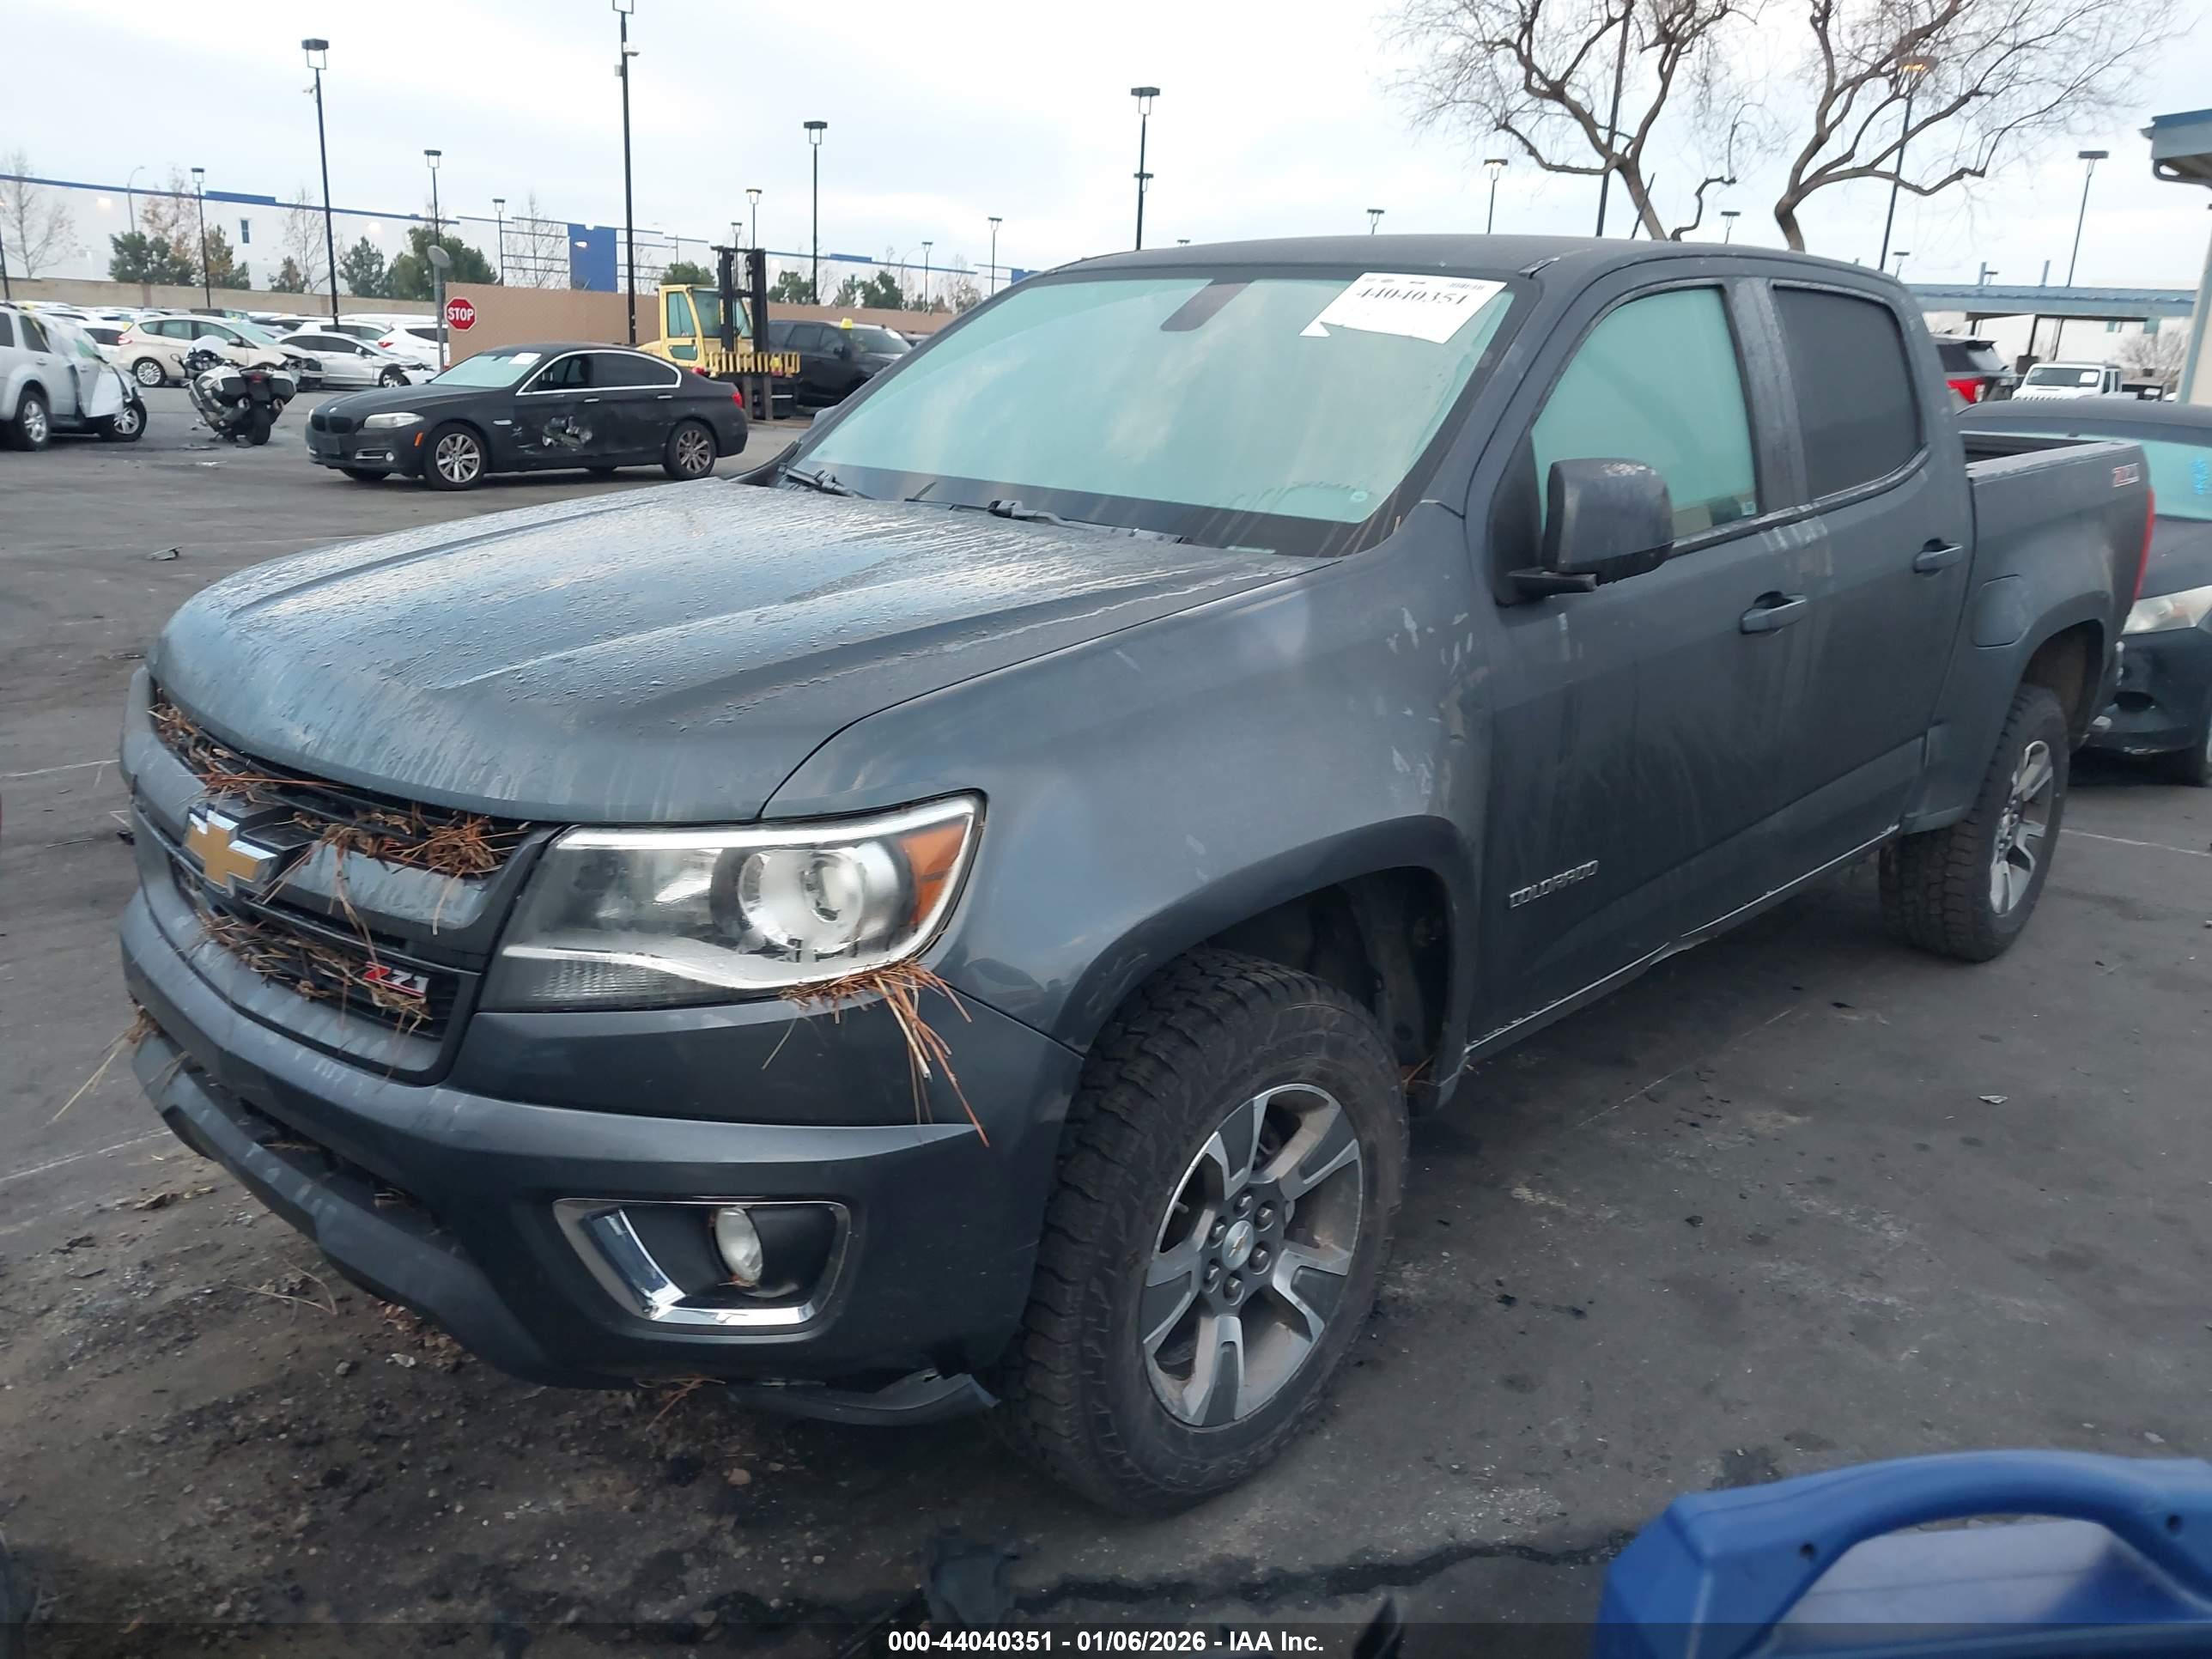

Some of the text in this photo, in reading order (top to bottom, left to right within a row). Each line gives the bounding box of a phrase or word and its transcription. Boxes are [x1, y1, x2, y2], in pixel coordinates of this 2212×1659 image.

[447, 307, 474, 321] STOP
[1510, 860, 1598, 908] COLORADO
[363, 962, 429, 997] Z71
